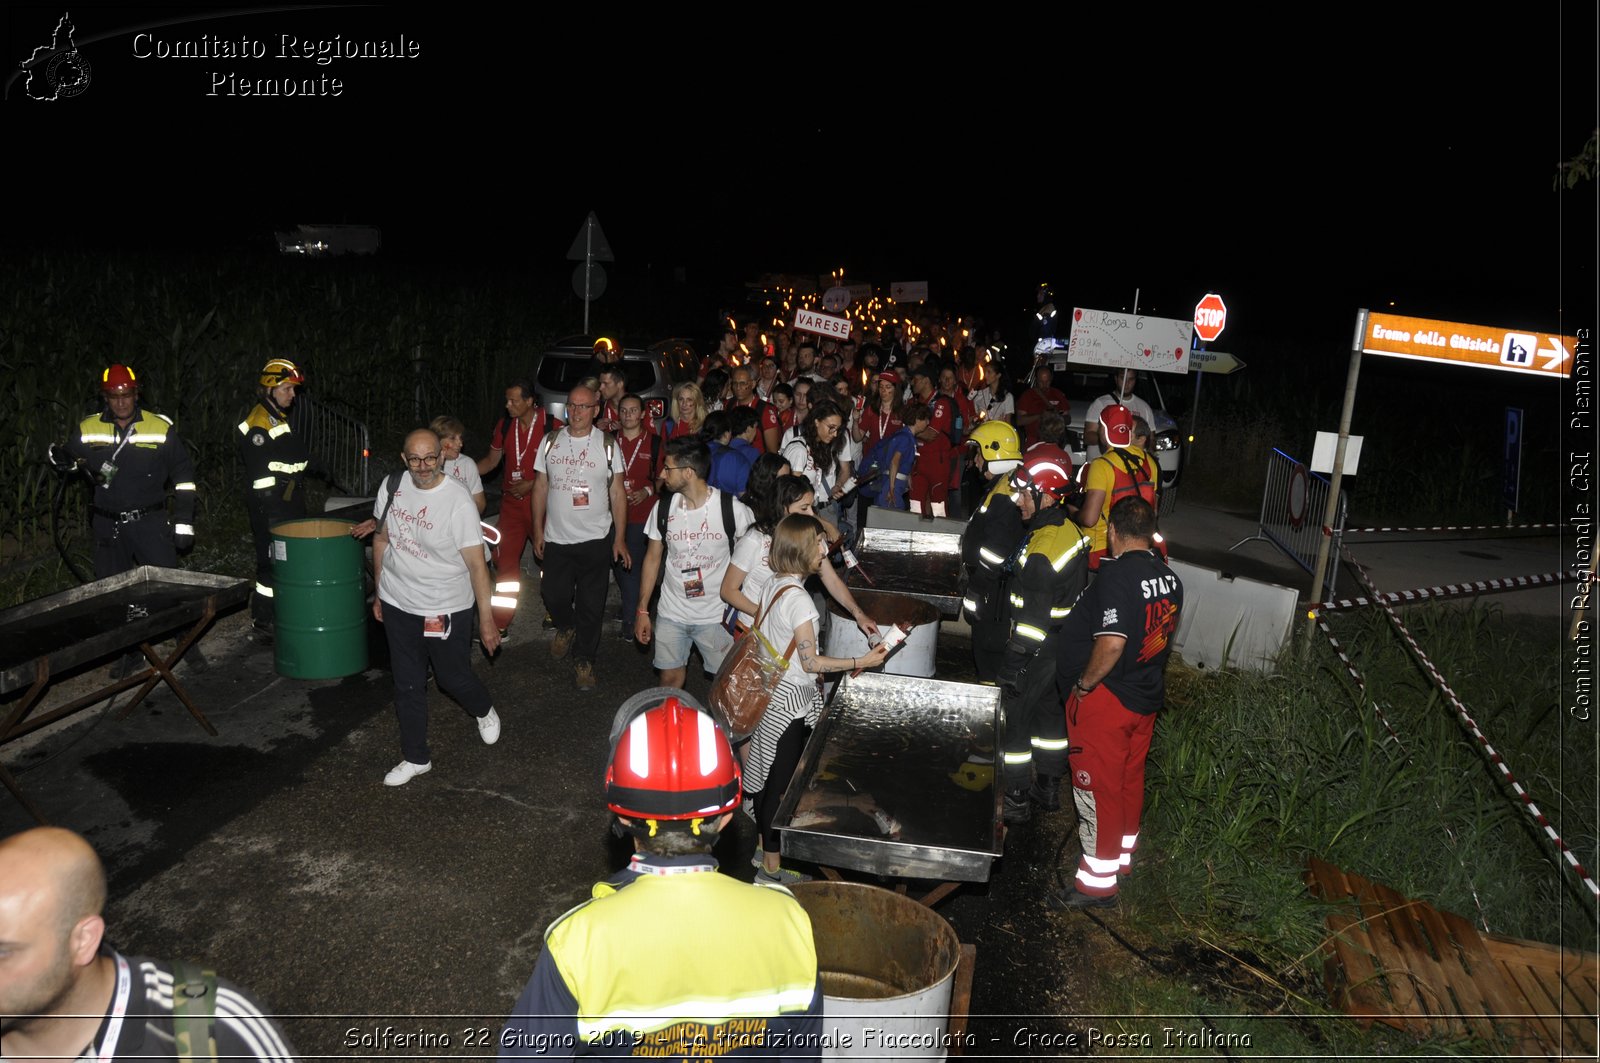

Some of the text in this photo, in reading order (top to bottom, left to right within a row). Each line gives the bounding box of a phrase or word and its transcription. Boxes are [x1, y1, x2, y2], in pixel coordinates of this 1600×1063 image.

[799, 313, 849, 335] VARESE
[1136, 317, 1144, 330] 6
[1196, 307, 1224, 328] STOP
[1372, 323, 1410, 343] Eremo
[1413, 331, 1446, 347] della
[1191, 352, 1217, 361] heggio
[550, 455, 596, 469] Solferino
[390, 503, 434, 530] Solferino
[666, 530, 723, 541] Solferino
[395, 541, 428, 559] Battaglia
[640, 1021, 708, 1045] ROVINCIA
[728, 1018, 767, 1035] PAVIA
